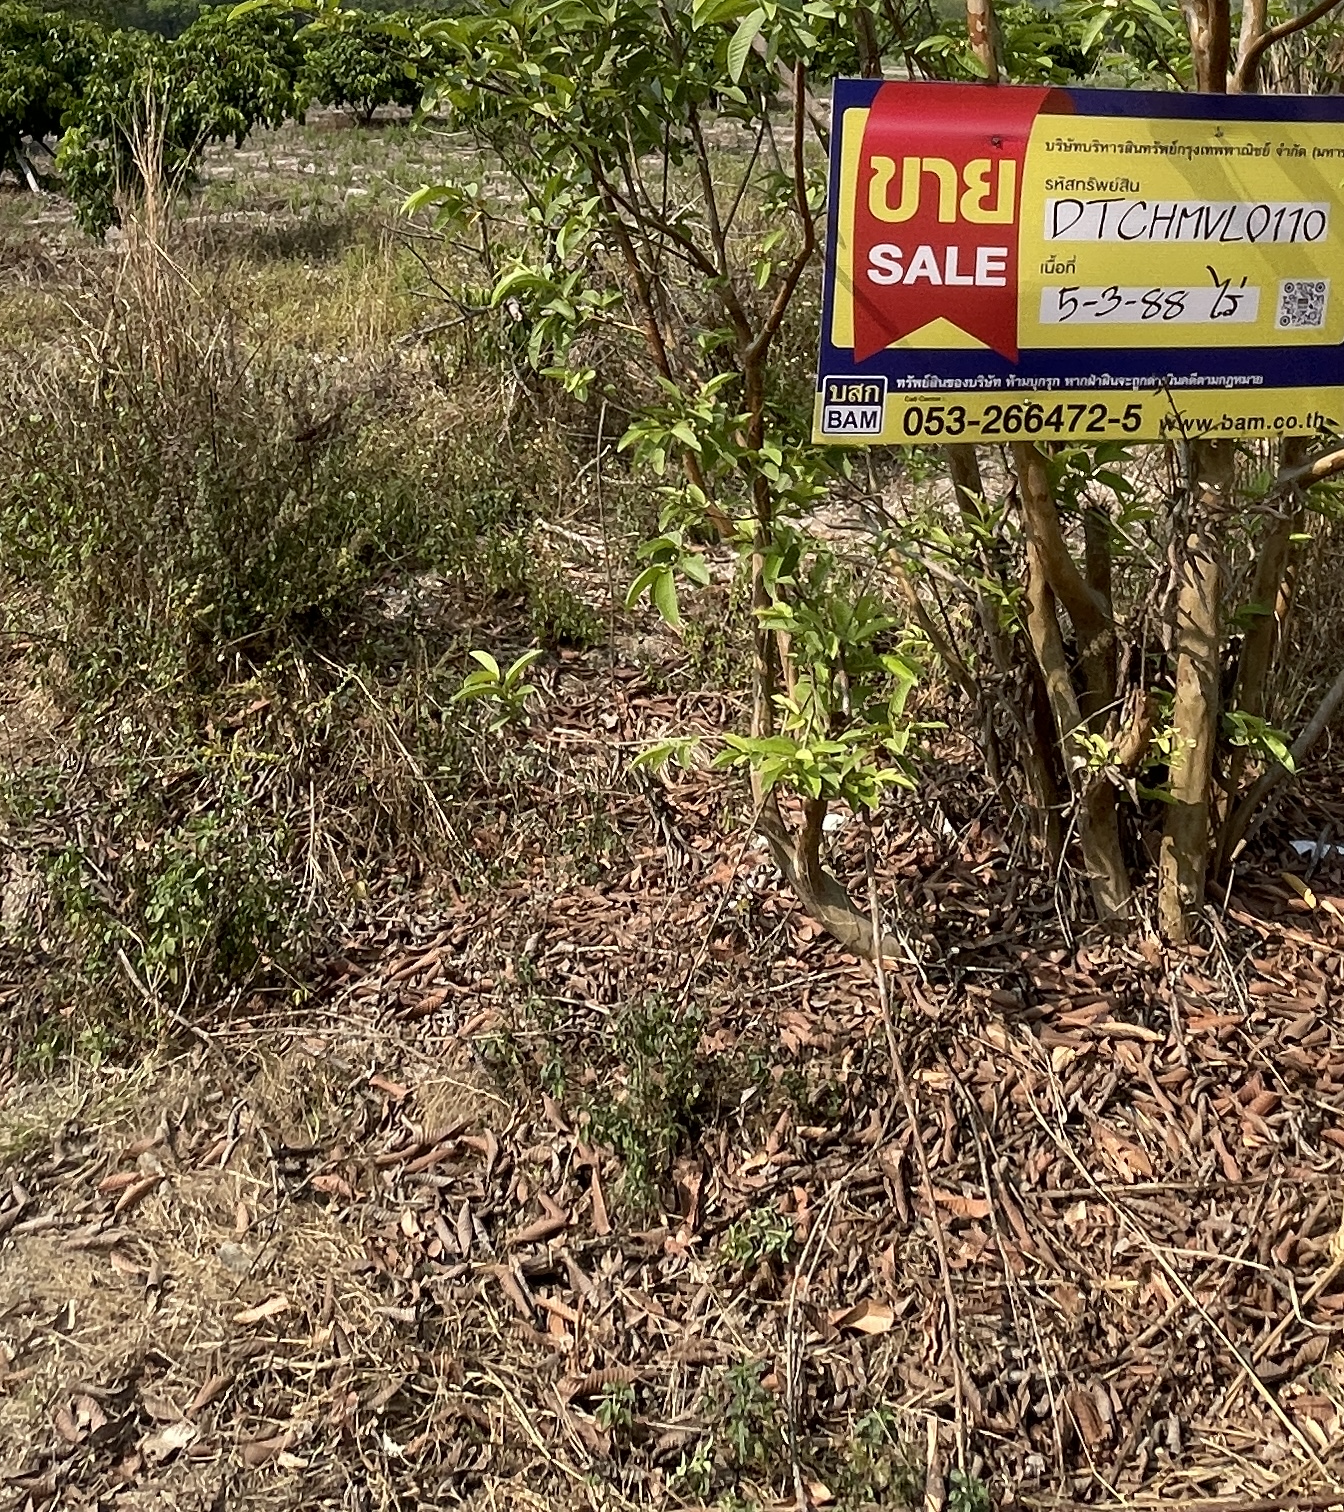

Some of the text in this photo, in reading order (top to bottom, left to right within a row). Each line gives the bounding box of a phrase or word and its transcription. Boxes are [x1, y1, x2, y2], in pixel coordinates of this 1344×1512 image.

[1276, 142, 1307, 158] จำกัด
[868, 156, 1016, 224] ขาย
[1045, 177, 1140, 194] รหัสทรัพย์สิน
[867, 243, 1008, 286] SALE
[1040, 255, 1077, 275] เนื้อที่
[1058, 285, 1191, 323] 5-3-88
[828, 383, 880, 403] บสก
[827, 410, 878, 430] BAM
[903, 403, 1143, 437] 053-266472-5
